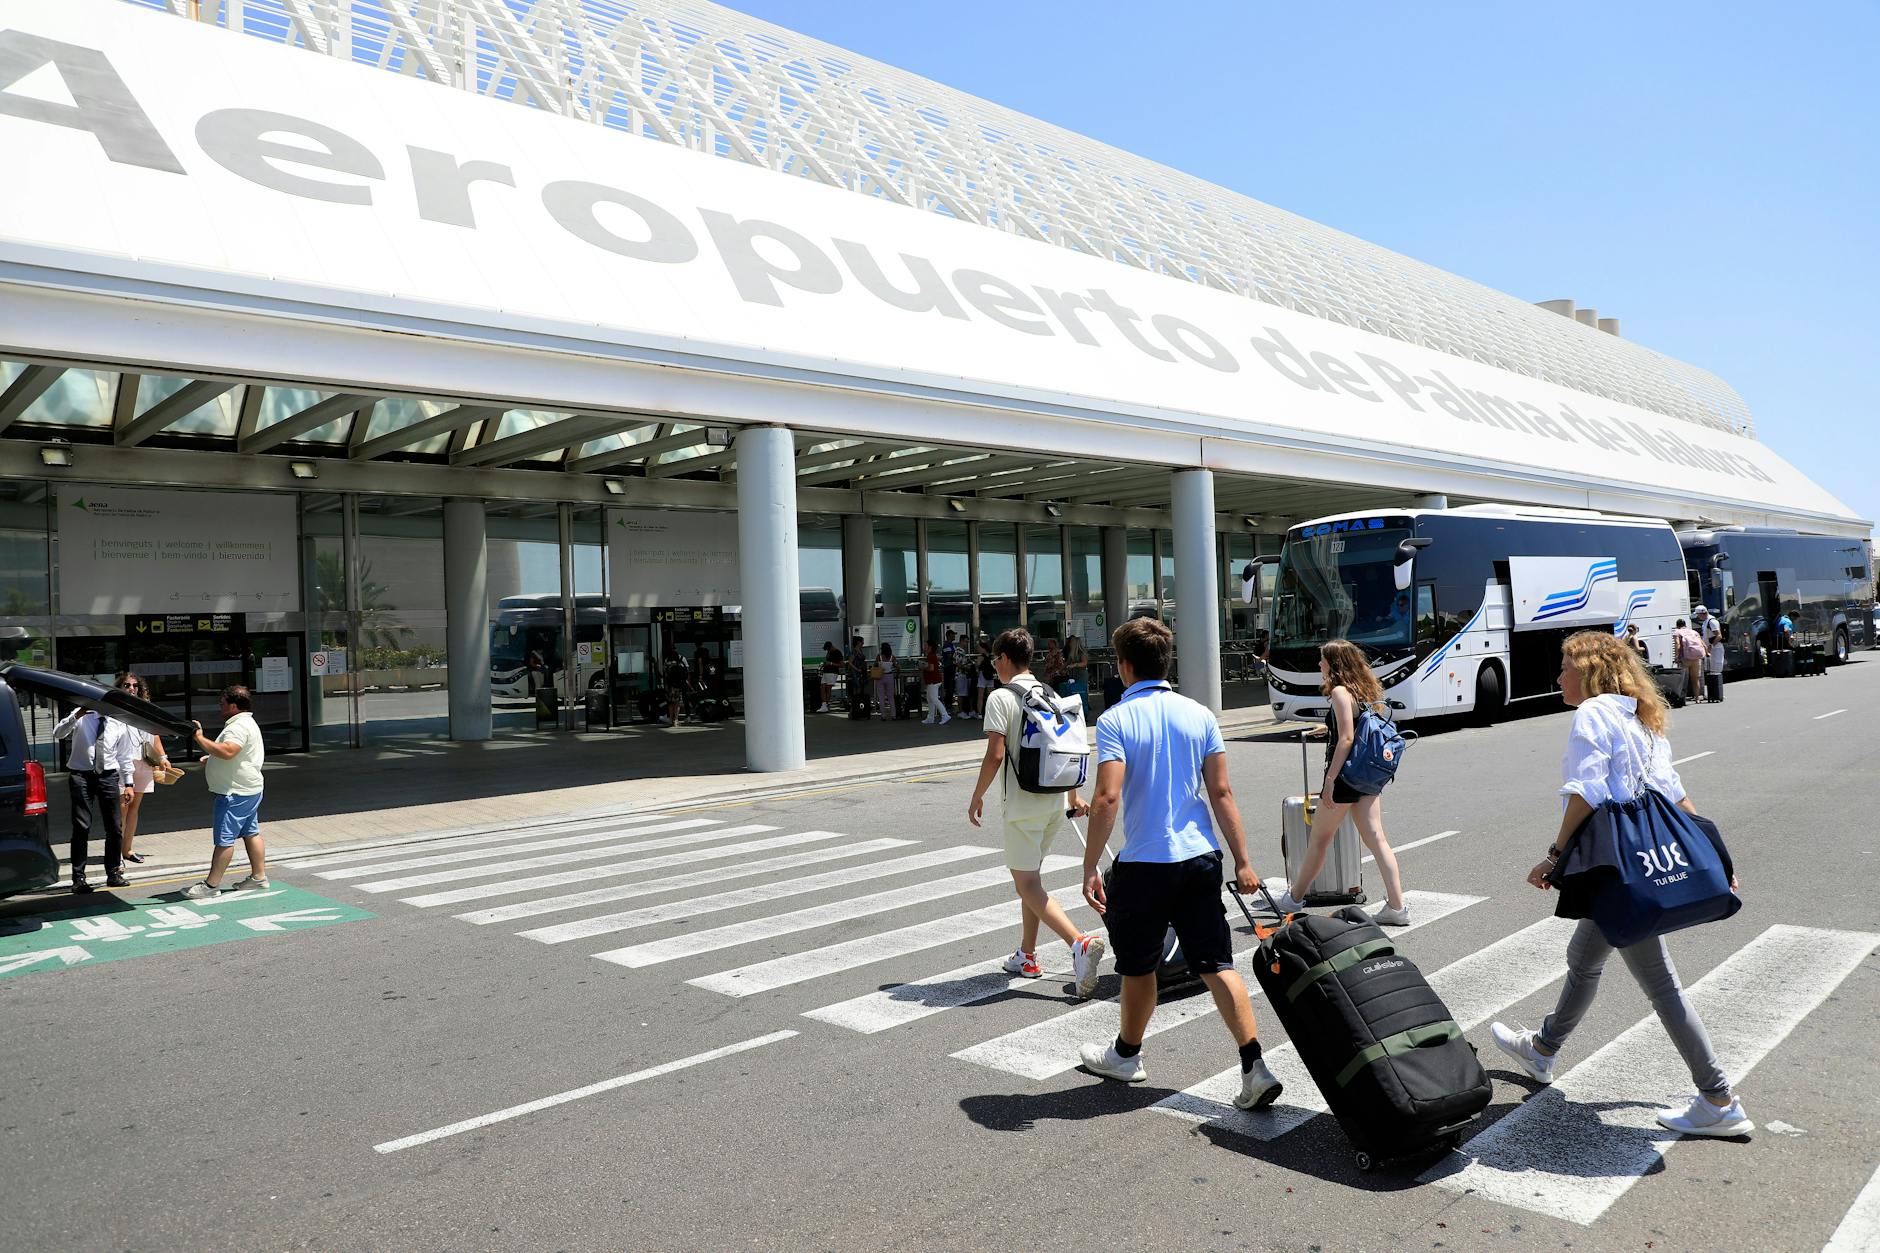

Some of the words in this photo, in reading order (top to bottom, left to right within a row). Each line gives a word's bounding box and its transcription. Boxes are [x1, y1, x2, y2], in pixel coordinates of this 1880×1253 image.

[0, 29, 1240, 373] Aeropuerto
[1250, 326, 1384, 402] de
[1354, 351, 1578, 443] Palma
[1559, 402, 1641, 456] de
[1607, 416, 1777, 485] Mallorca
[165, 540, 204, 549] welcome
[215, 541, 265, 550] willkommen
[101, 550, 150, 559] bienvenue
[219, 551, 265, 560] bienvenido
[1653, 878, 1668, 887] TUI
[1668, 871, 1689, 883] BLUE
